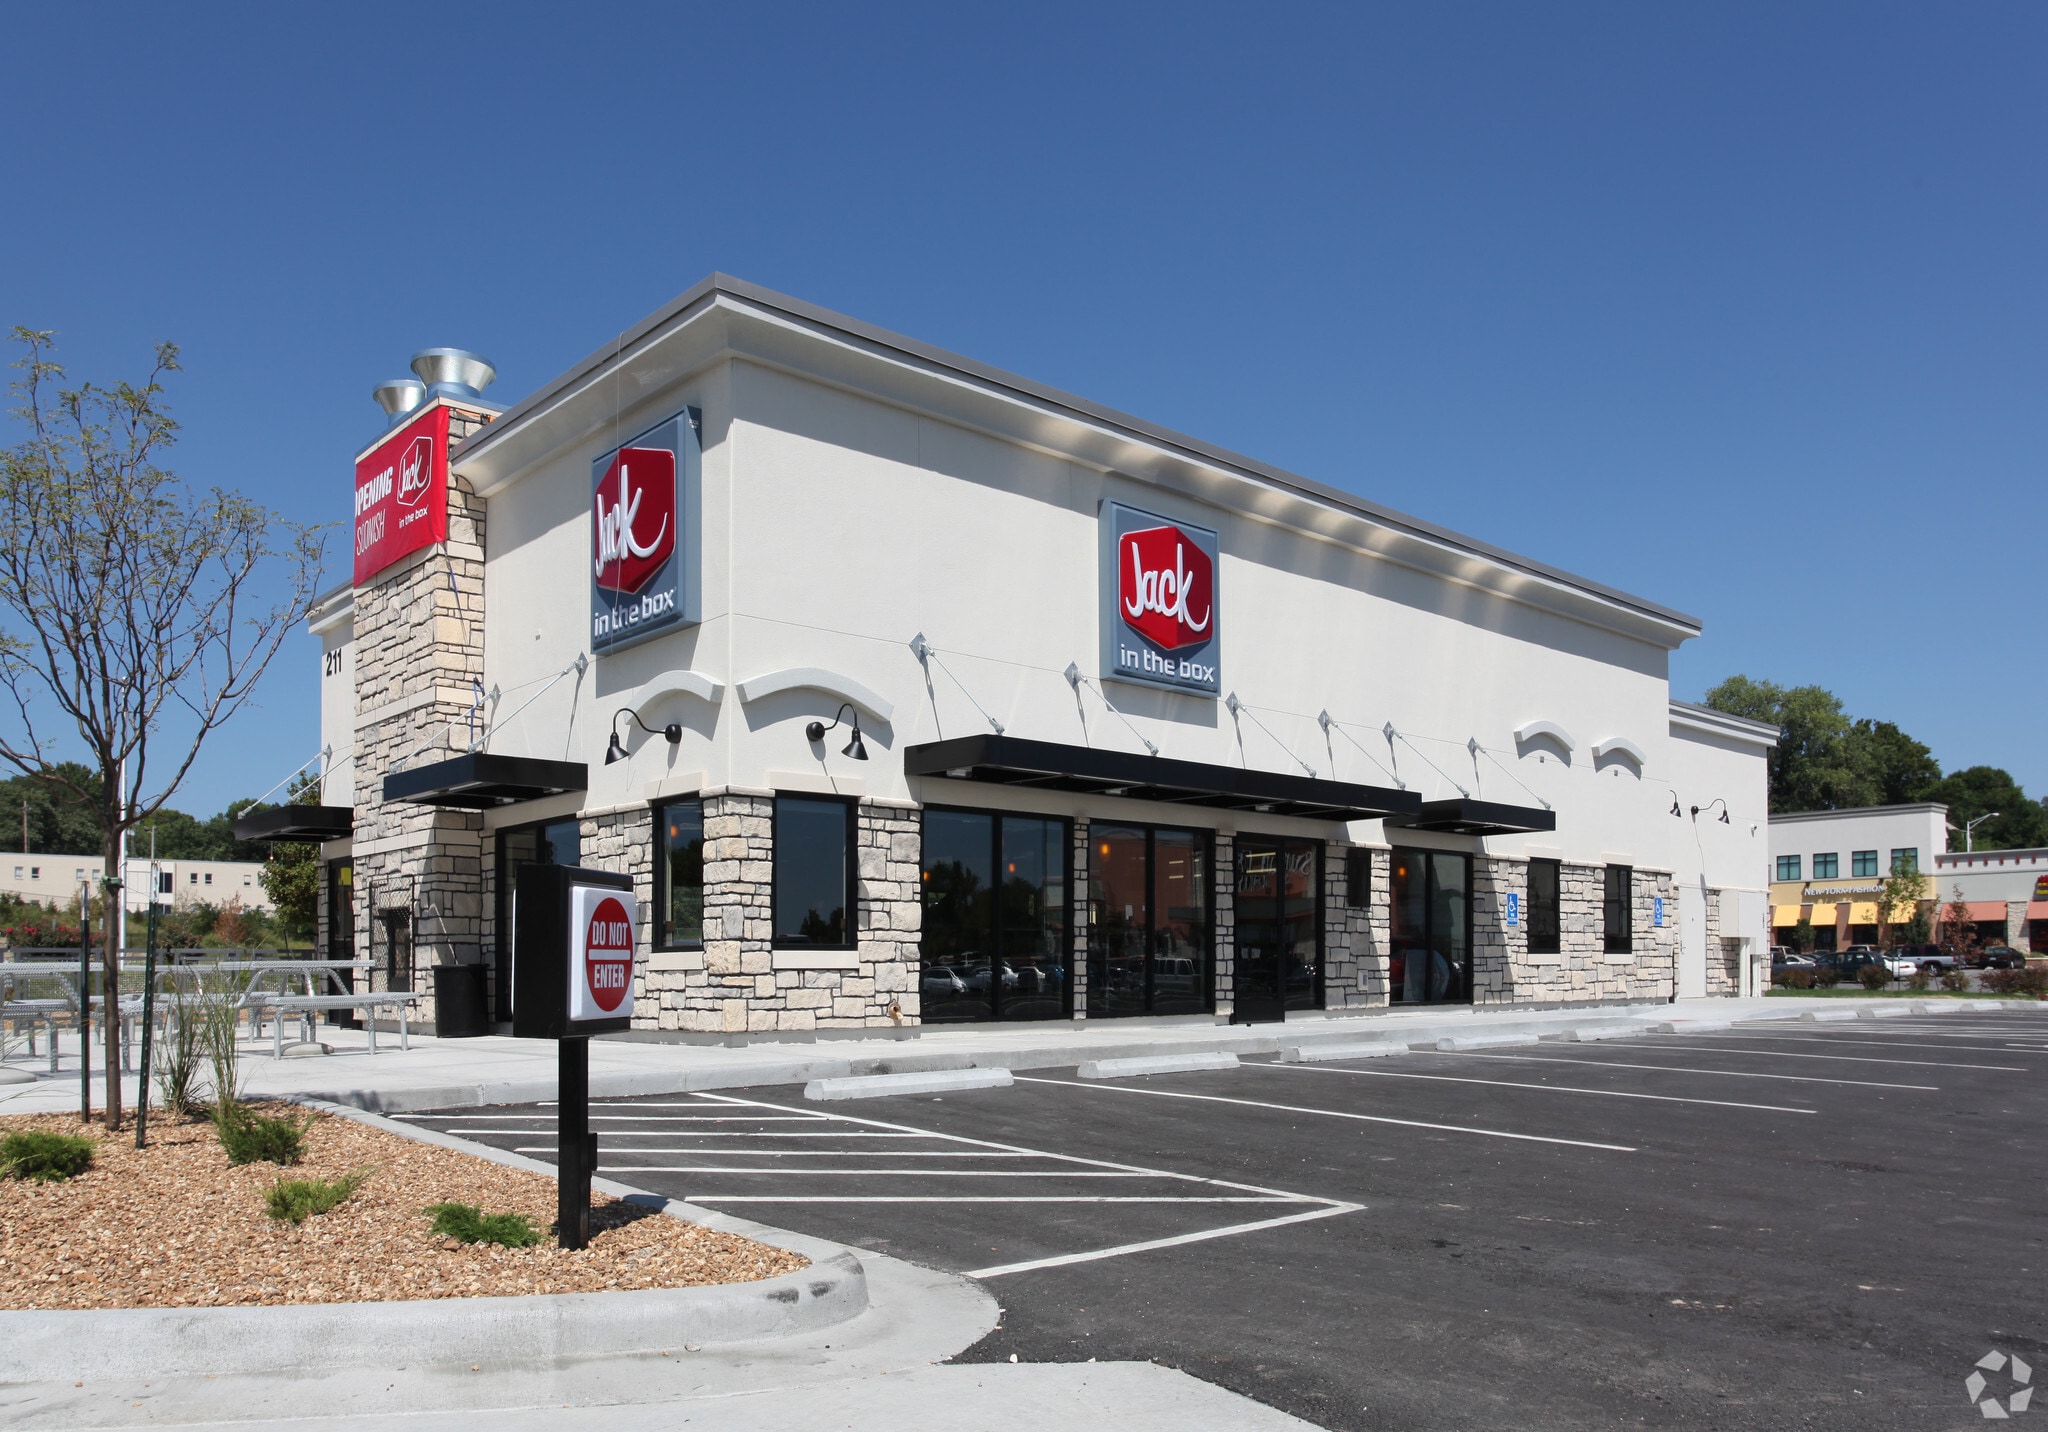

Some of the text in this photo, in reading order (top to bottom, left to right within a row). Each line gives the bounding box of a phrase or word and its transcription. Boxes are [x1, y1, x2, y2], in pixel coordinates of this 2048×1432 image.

[399, 444, 430, 499] Jack
[399, 507, 428, 529] in the box
[595, 464, 668, 578] Jack
[1125, 541, 1210, 632] Jack
[594, 590, 675, 637] in the box
[326, 647, 342, 677] 211
[1120, 643, 1214, 683] in the box
[592, 921, 628, 946] DO NOT
[594, 964, 625, 989] ENTER
